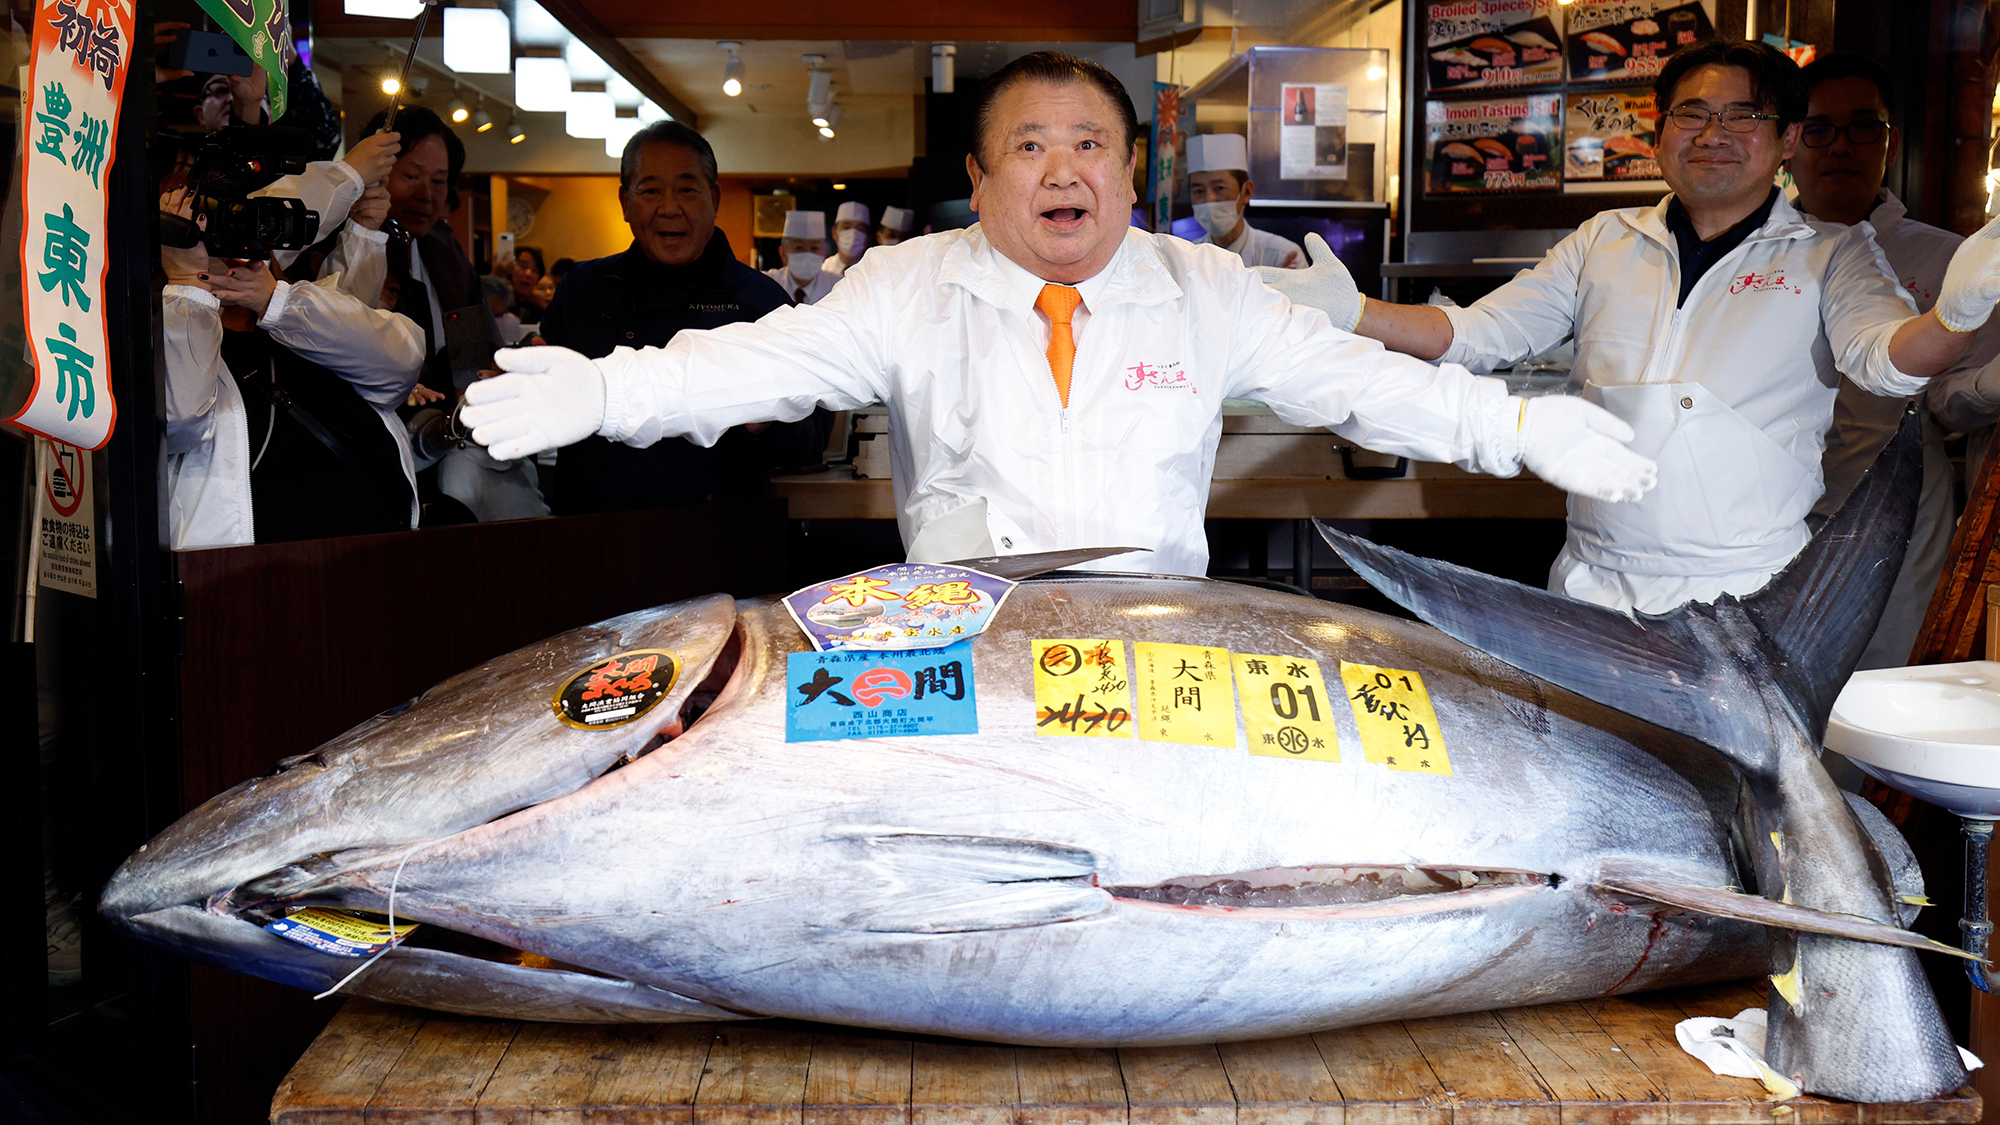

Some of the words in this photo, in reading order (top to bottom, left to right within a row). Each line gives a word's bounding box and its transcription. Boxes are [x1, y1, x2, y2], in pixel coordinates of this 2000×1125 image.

[1431, 1, 1477, 19] Broiled
[1481, 66, 1523, 83] 910円
[1430, 107, 1477, 120] Salmon
[1481, 103, 1530, 119] Tasting
[1624, 100, 1652, 110] Whale
[35, 80, 110, 191] 豊洲
[1484, 171, 1525, 188] 773円
[688, 303, 740, 311] KIYOMURA
[41, 516, 91, 540] 飲食物の持込は
[42, 533, 91, 555] ご遠慮ください
[815, 653, 870, 664] 青森県産
[1201, 650, 1217, 680] 青森県
[1172, 658, 1204, 712] 大間
[1270, 682, 1321, 722] 01
[852, 708, 907, 719] 西山商店
